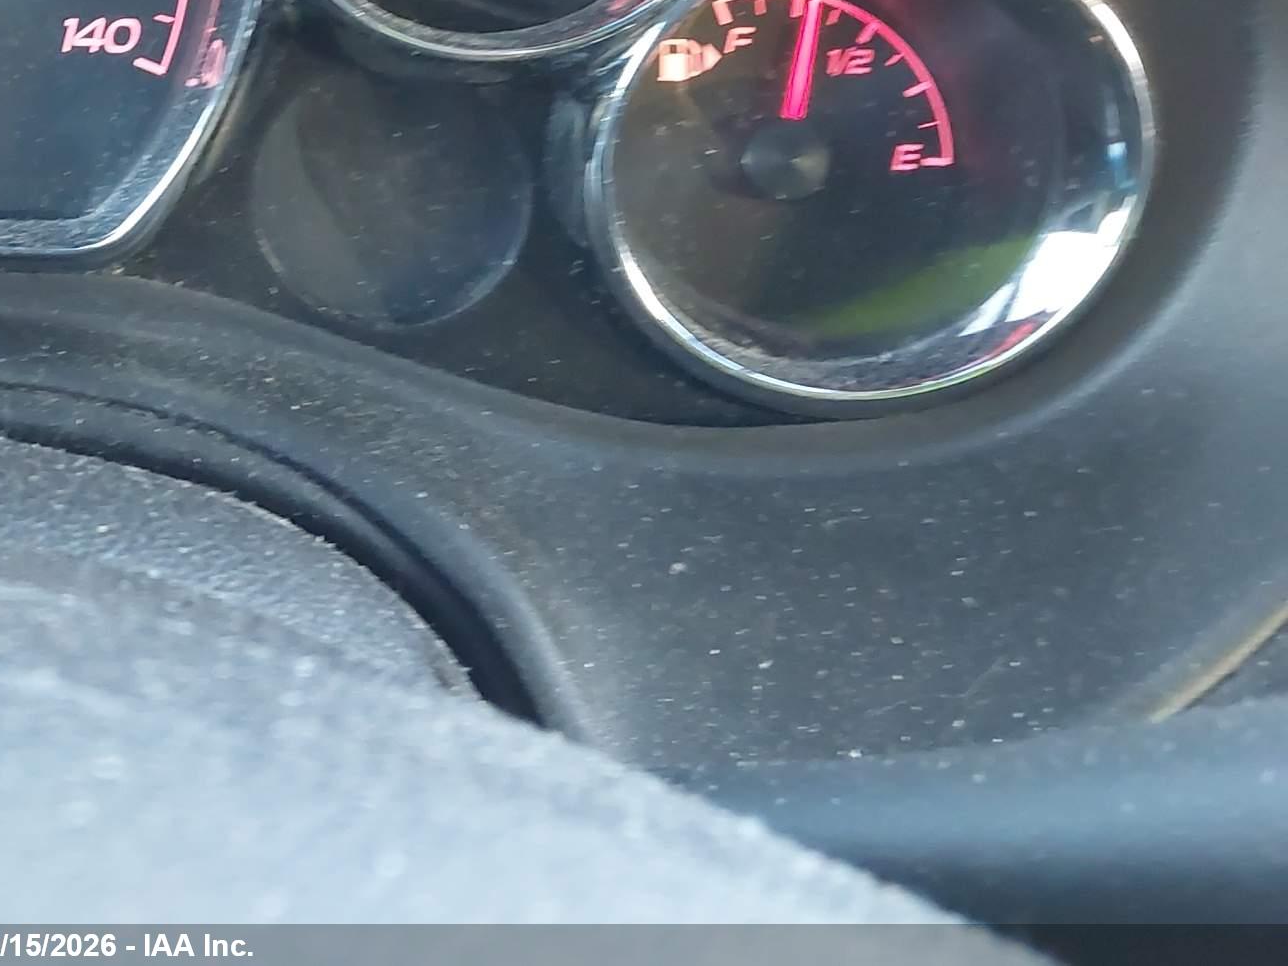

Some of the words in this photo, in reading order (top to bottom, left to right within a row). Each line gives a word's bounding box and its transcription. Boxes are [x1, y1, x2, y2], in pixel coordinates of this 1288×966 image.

[62, 18, 141, 53] 140
[723, 26, 757, 53] F
[890, 144, 925, 170] E
